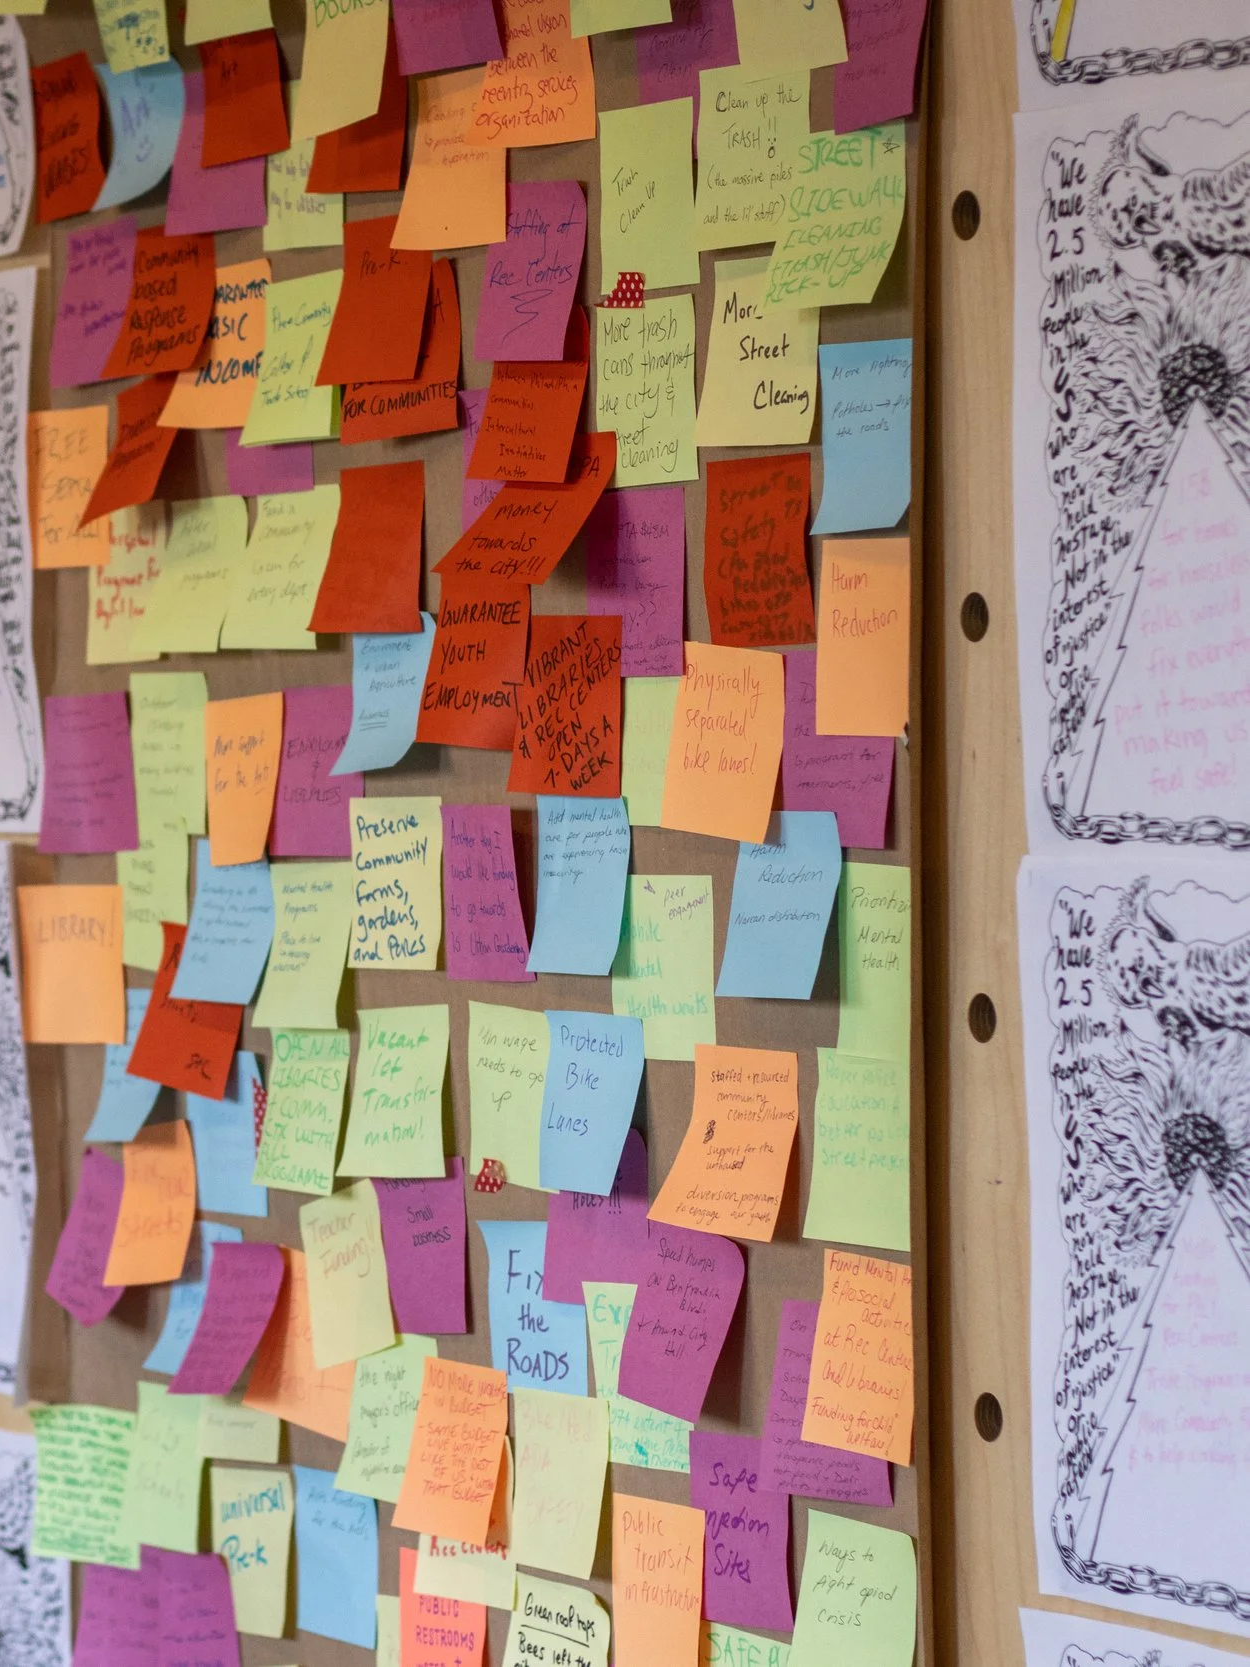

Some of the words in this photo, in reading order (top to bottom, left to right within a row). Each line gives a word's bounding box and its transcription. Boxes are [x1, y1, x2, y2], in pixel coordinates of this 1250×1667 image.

[542, 44, 558, 63] the
[715, 90, 749, 113] Clean
[756, 94, 768, 117] up
[776, 84, 800, 103] the
[475, 104, 566, 140] organization
[722, 123, 760, 150] TRASH
[798, 128, 882, 174] STREET
[732, 167, 764, 184] massive
[770, 165, 792, 189] piles
[620, 202, 645, 233] Clean
[703, 213, 718, 225] and
[723, 206, 738, 222] the
[1048, 187, 1085, 223] have
[783, 216, 882, 250] CLEANING
[1047, 226, 1086, 262] 2.5
[526, 250, 573, 286] Centers
[1048, 262, 1105, 309] Million
[604, 317, 630, 346] More
[638, 309, 677, 347] trash
[740, 333, 789, 361] Street
[603, 352, 633, 380] cans
[832, 366, 861, 380] More
[343, 398, 366, 422] FOR
[370, 381, 458, 420] COMMUNITIES
[600, 395, 618, 416] the
[626, 382, 660, 418] city
[754, 381, 809, 414] Cleaning
[622, 439, 678, 473] cleaning
[1053, 465, 1078, 486] are
[495, 500, 558, 523] money
[1063, 493, 1098, 530] held
[469, 532, 537, 551] towards
[456, 558, 481, 573] the
[831, 562, 868, 593] Harm
[1061, 554, 1090, 604] Not
[1093, 550, 1108, 572] in
[1111, 529, 1135, 556] the
[440, 600, 521, 628] GUARANTEE
[1052, 578, 1110, 632] interest
[831, 607, 898, 639] Reduction
[440, 637, 486, 675] YOUTH
[527, 621, 589, 688] VIBRANT
[1045, 635, 1062, 665] of
[423, 680, 524, 717] EMPLOYMENT
[519, 637, 602, 730] LIBRARIES
[535, 707, 564, 744] REC
[569, 638, 622, 711] CENTERS
[684, 663, 765, 710] Physically
[685, 707, 748, 742] separated
[1114, 704, 1143, 734] put
[549, 712, 582, 761] OPEN
[561, 726, 600, 773] DAYS
[602, 715, 614, 737] A
[1122, 727, 1208, 758] making
[570, 752, 614, 791] WEEK
[683, 751, 711, 773] bike
[717, 743, 758, 775] lanes!
[356, 814, 419, 841] Preserve
[569, 808, 595, 822] mental
[599, 808, 622, 822] health
[566, 831, 580, 845] for
[583, 828, 614, 845] people
[750, 843, 786, 860] Harm
[355, 836, 428, 871] Community
[758, 864, 823, 884] Reduction
[357, 905, 419, 943] gardens,
[857, 925, 903, 944] Mental
[353, 942, 383, 962] and
[387, 934, 426, 960] Parks
[862, 951, 900, 971] Health
[1054, 936, 1094, 970] have
[1055, 979, 1093, 1008] 2.5
[274, 1033, 325, 1062] OPEN
[367, 1016, 429, 1051] Vacant
[503, 1035, 538, 1053] wage
[561, 1025, 623, 1057] Protected
[1056, 1017, 1113, 1055] Million
[510, 1068, 521, 1078] to
[529, 1072, 544, 1088] go
[566, 1062, 599, 1090] Bike
[711, 1067, 742, 1083] staffed
[716, 1092, 767, 1112] community
[548, 1103, 589, 1136] Lanes
[707, 1145, 740, 1160] support
[744, 1144, 755, 1153] for
[759, 1142, 774, 1153] the
[686, 1184, 738, 1202] diversion
[741, 1193, 779, 1210] programs
[407, 1205, 434, 1224] Small
[676, 1200, 686, 1213] to
[688, 1207, 720, 1226] engage
[1065, 1211, 1087, 1231] are
[658, 1239, 684, 1263] Speed
[1073, 1252, 1105, 1279] held
[830, 1252, 862, 1276] Fund
[866, 1259, 898, 1285] Mental
[518, 1302, 550, 1333] the
[1071, 1303, 1100, 1349] Not
[1101, 1294, 1116, 1318] in
[1117, 1286, 1140, 1307] the
[824, 1326, 840, 1347] at
[845, 1323, 869, 1356] Rec
[1063, 1325, 1120, 1377] interest
[506, 1337, 570, 1382] ROADS
[1055, 1379, 1071, 1409] of
[812, 1396, 854, 1432] Funding
[709, 1462, 758, 1494] Safe
[635, 1543, 694, 1569] transit
[714, 1543, 751, 1583] Sites
[818, 1540, 856, 1568] Ways
[862, 1548, 874, 1562] to
[813, 1574, 855, 1592] fight
[524, 1592, 553, 1622] Green
[416, 1625, 475, 1651] RESTROOMS
[518, 1631, 545, 1661] Bees
[552, 1649, 571, 1666] left
